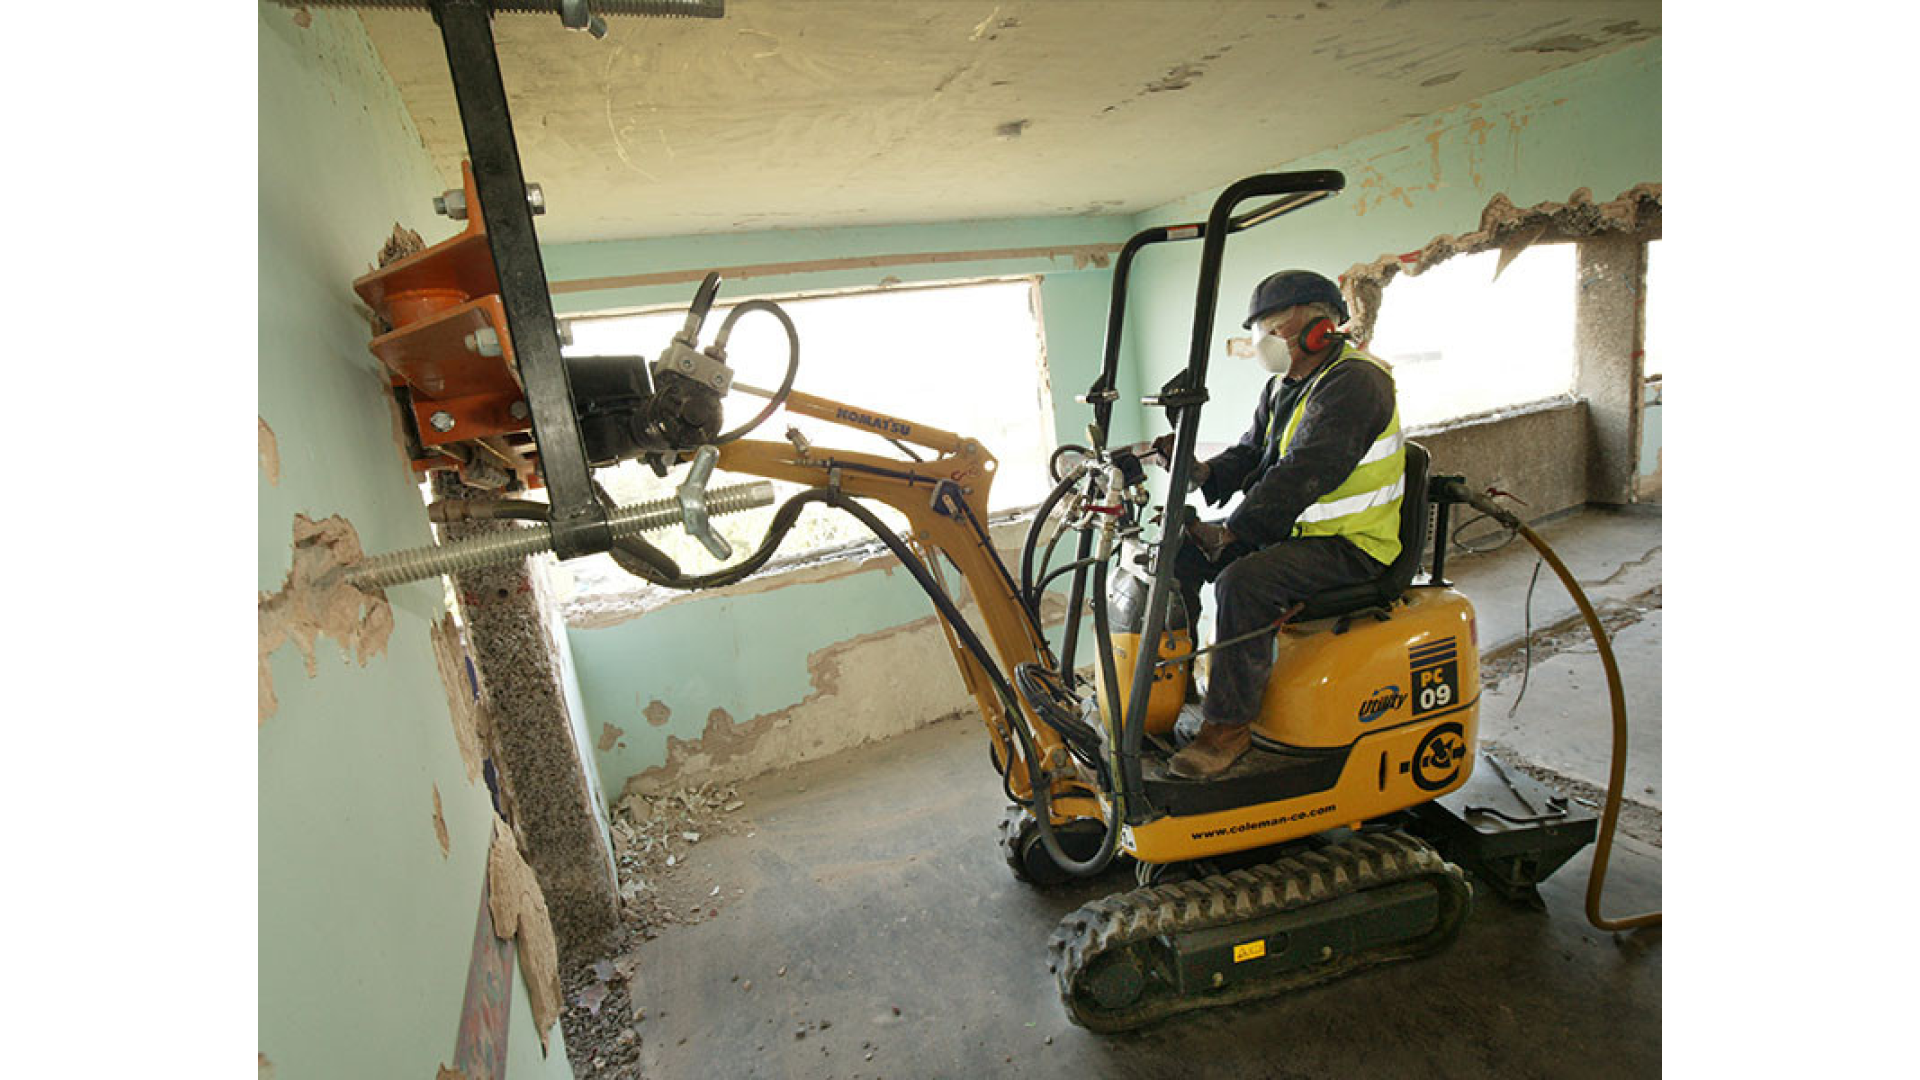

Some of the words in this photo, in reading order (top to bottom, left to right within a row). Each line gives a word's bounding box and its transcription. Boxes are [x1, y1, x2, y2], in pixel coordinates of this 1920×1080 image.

[836, 407, 911, 435] KOMATSU
[1421, 667, 1443, 687] PC
[1358, 692, 1408, 719] Utility
[1421, 683, 1451, 709] 09
[1191, 803, 1337, 840] www.coleman-co.com
